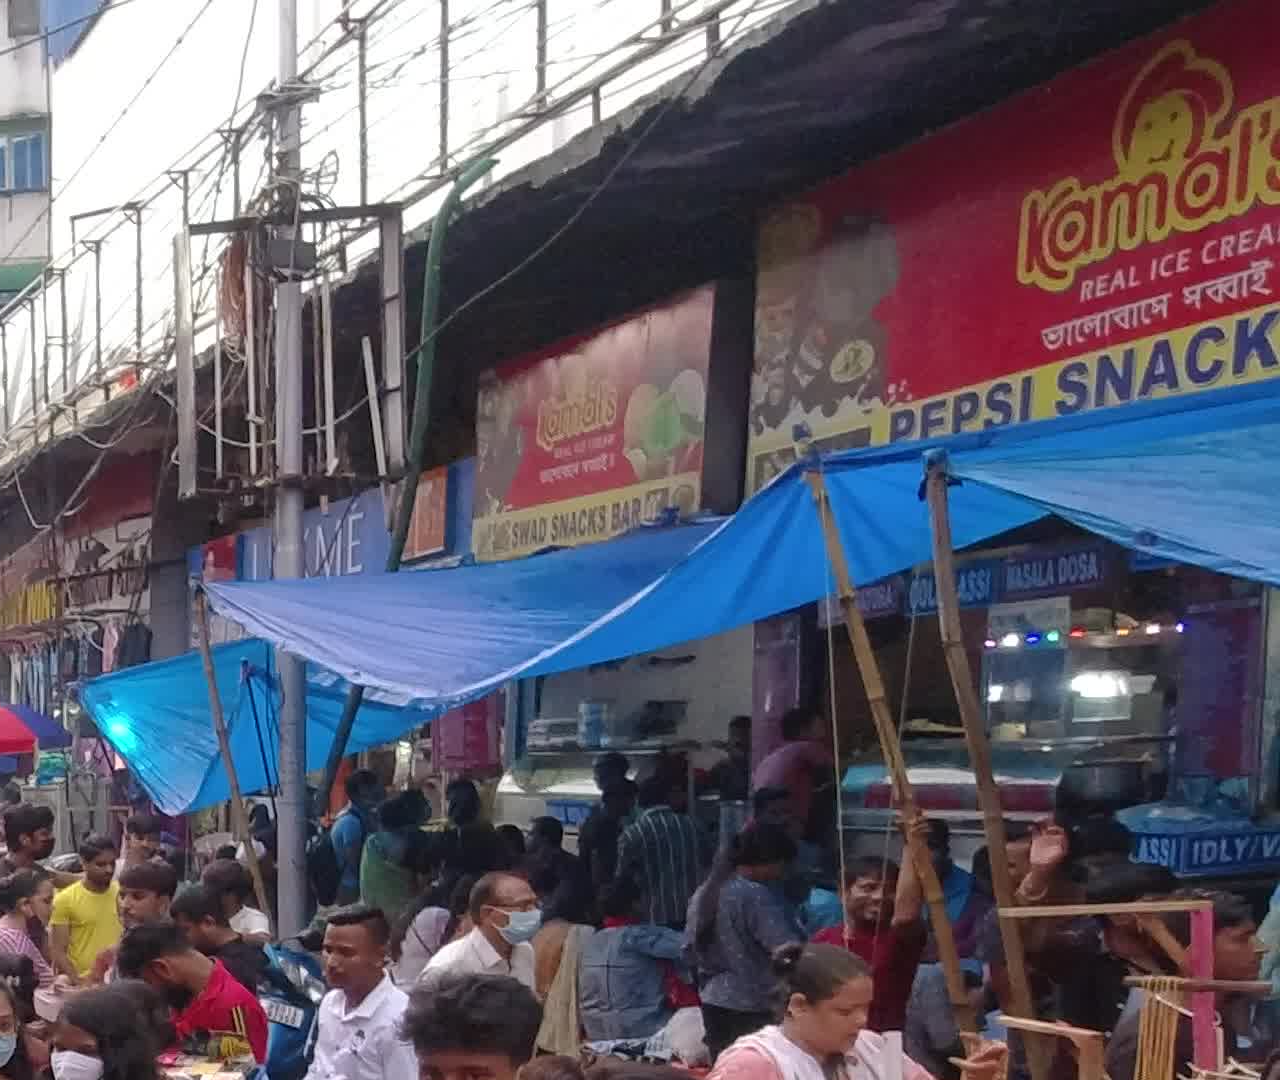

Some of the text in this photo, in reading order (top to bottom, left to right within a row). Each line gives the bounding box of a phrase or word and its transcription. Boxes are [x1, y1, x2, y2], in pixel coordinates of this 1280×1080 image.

[1079, 222, 1280, 303] REAL ICE CREA
[889, 375, 1035, 444] PEPSI
[550, 507, 608, 542] SNACKS
[1057, 551, 1099, 586] DOSA
